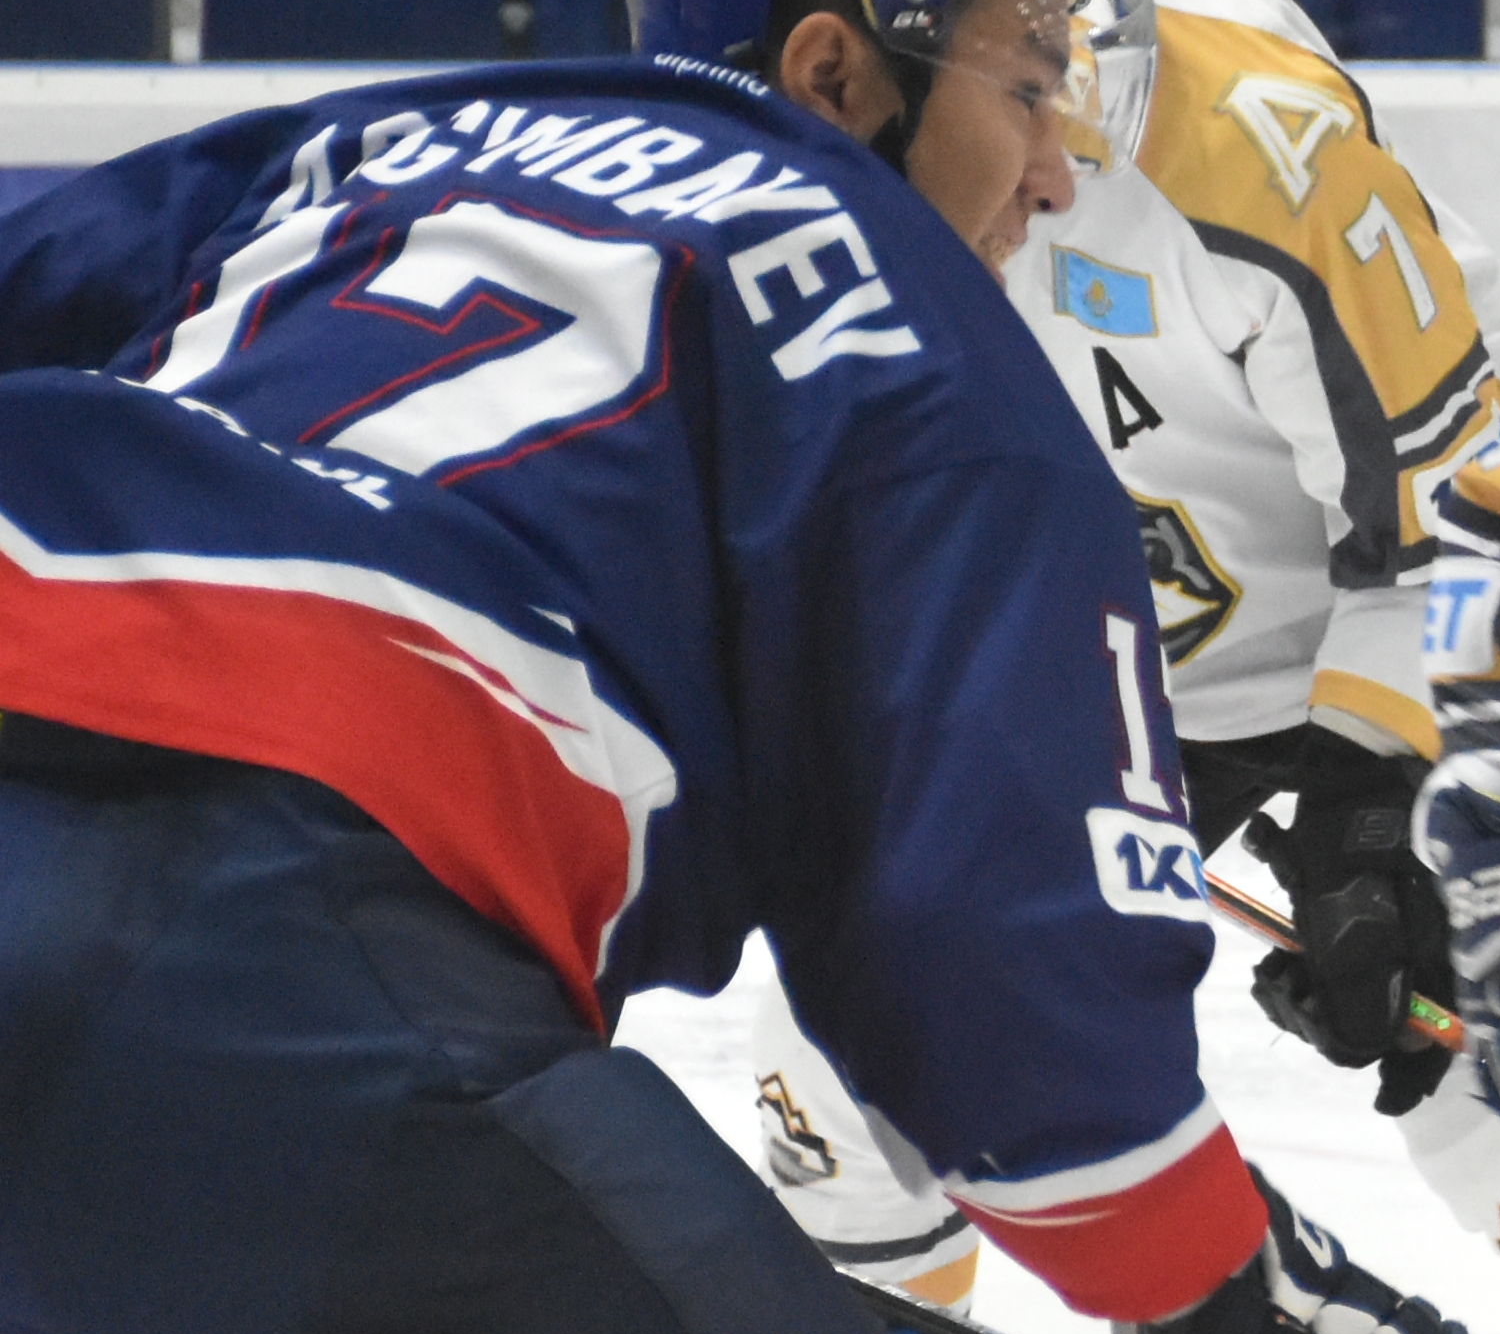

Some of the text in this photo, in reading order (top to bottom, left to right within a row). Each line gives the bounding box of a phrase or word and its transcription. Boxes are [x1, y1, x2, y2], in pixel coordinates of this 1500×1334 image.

[1212, 69, 1358, 218] A
[143, 197, 664, 479] 17
[1093, 346, 1164, 451] A
[1104, 612, 1192, 825] 1
